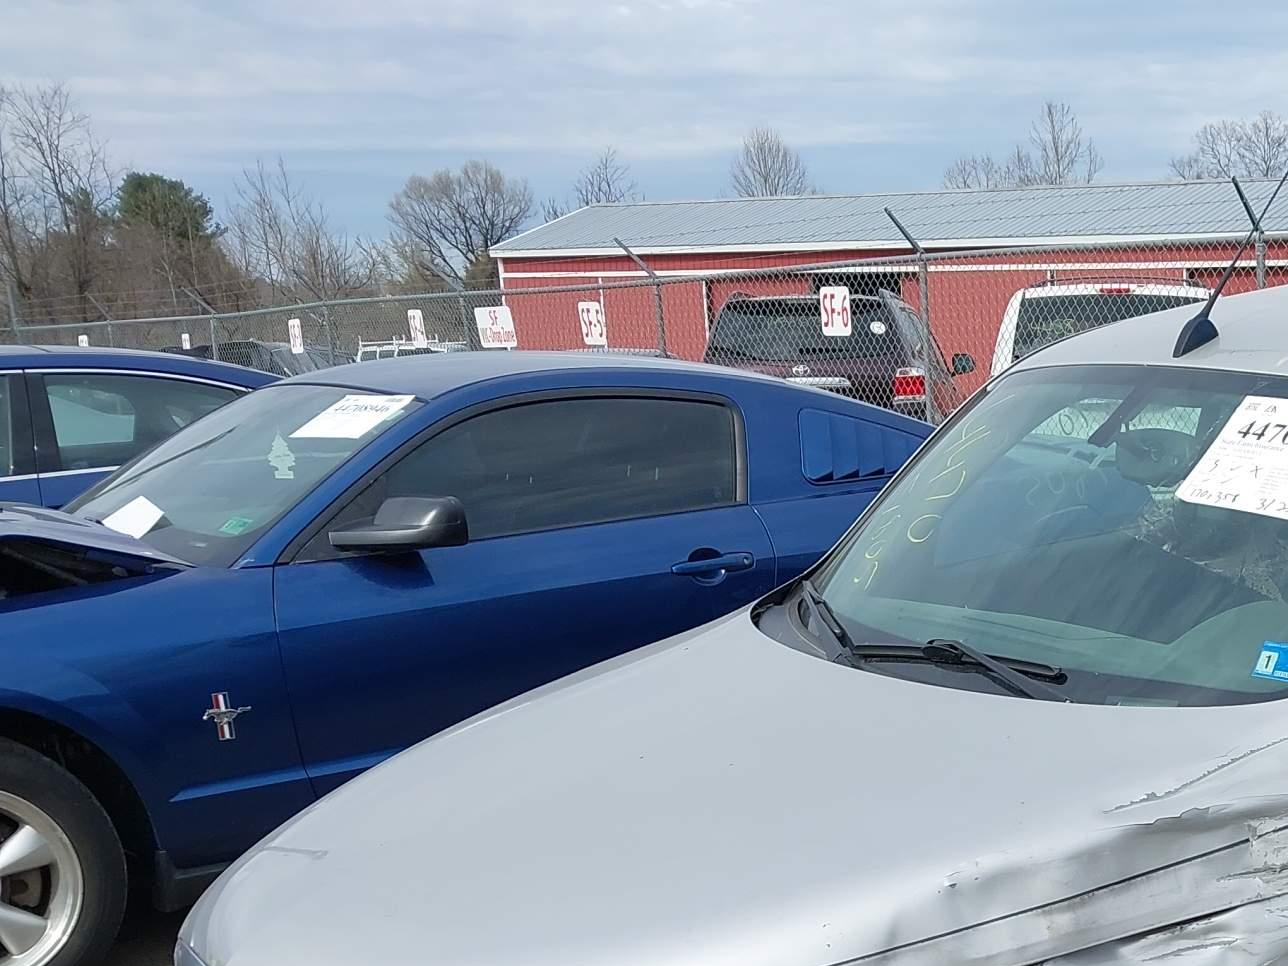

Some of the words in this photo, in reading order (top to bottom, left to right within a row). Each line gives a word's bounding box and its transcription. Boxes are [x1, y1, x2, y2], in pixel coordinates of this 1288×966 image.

[489, 309, 498, 326] SF
[581, 307, 603, 338] SF-5
[823, 293, 849, 328] SF-6
